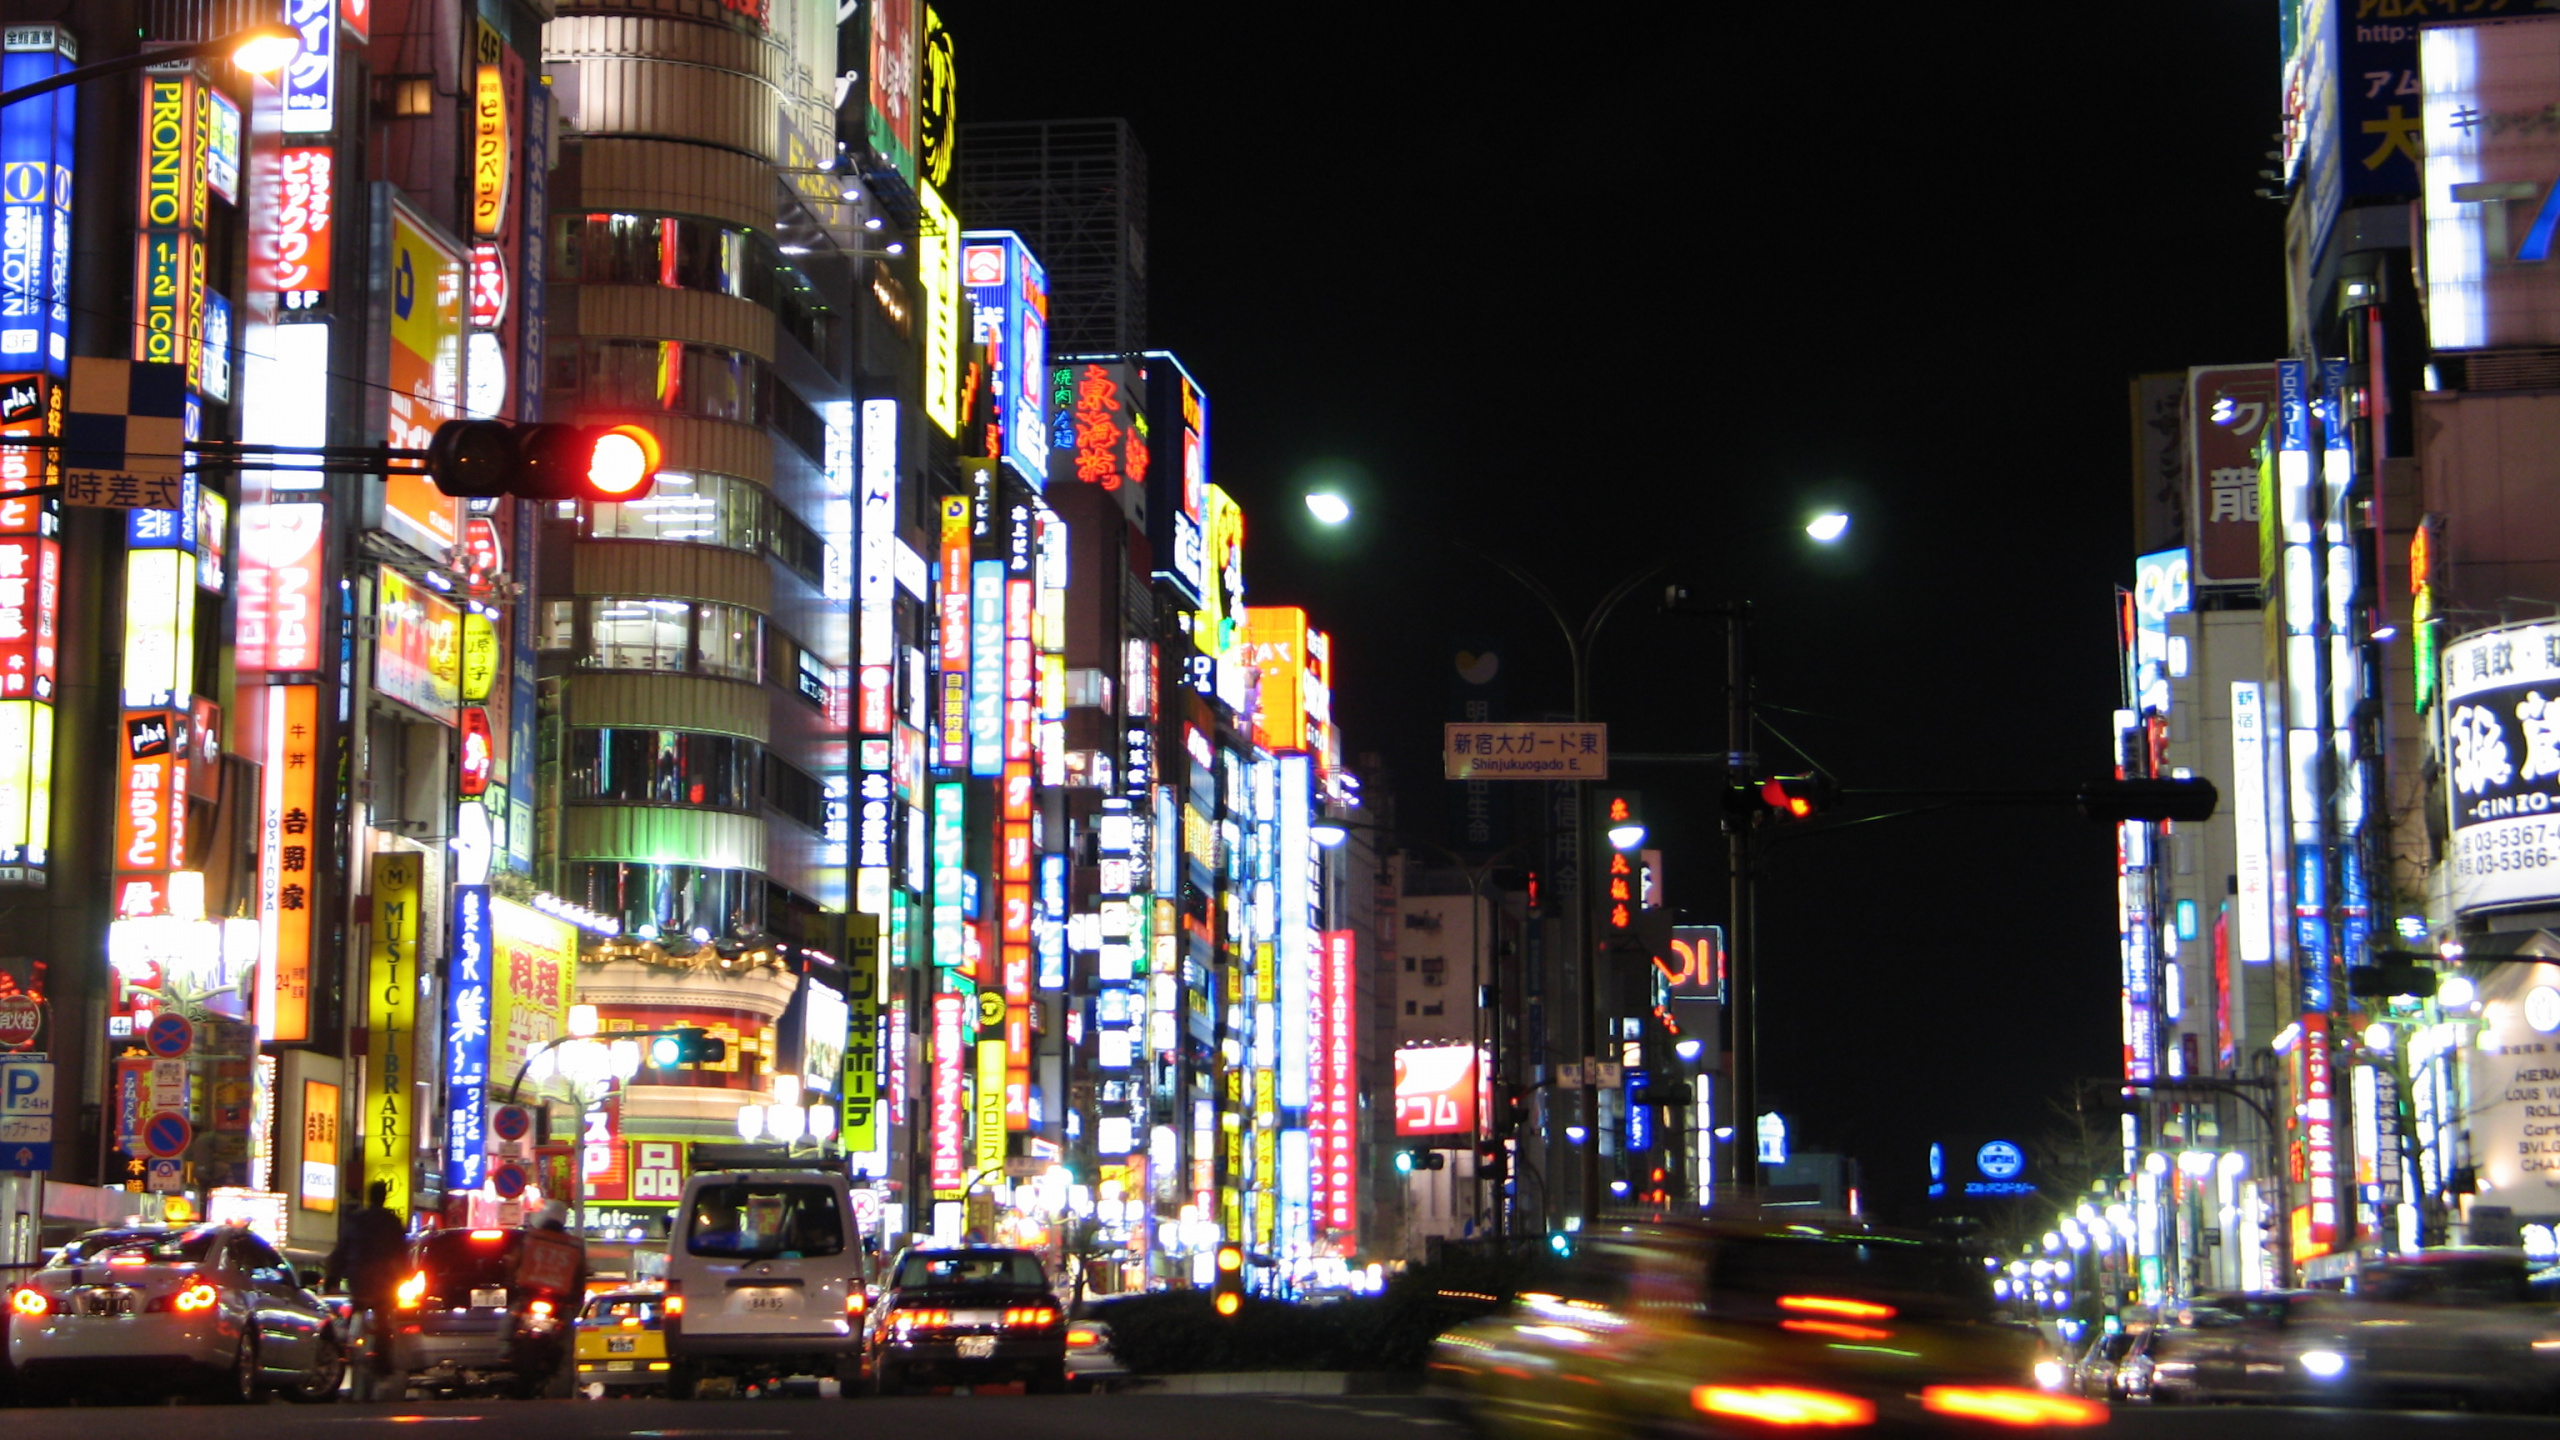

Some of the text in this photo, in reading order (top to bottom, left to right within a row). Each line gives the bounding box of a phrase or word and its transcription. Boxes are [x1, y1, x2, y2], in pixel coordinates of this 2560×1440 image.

[150, 82, 182, 225] PRONTO
[192, 87, 207, 230] PRONTO
[310, 153, 331, 232] カラオケ
[187, 243, 202, 387] PRONTO
[68, 473, 178, 509] 時差式
[289, 723, 307, 769] 牛丼
[1454, 733, 1599, 755] 新宿大ガード東
[1471, 758, 1581, 773] Shinjukuogado E.
[2475, 824, 2560, 852] 03-5367-
[265, 808, 278, 911] YOSHINOYA
[281, 807, 308, 911] 吉野家
[2475, 846, 2560, 875] 03-5366-
[112, 1018, 131, 1034] 4F
[380, 901, 406, 1158] MUSIC LIBRARY
[7, 1068, 40, 1109] P
[21, 1096, 49, 1109] 24H
[2504, 1087, 2540, 1101] LOUIS
[3, 1121, 48, 1137] サブナード
[982, 1092, 999, 1161] プロミス
